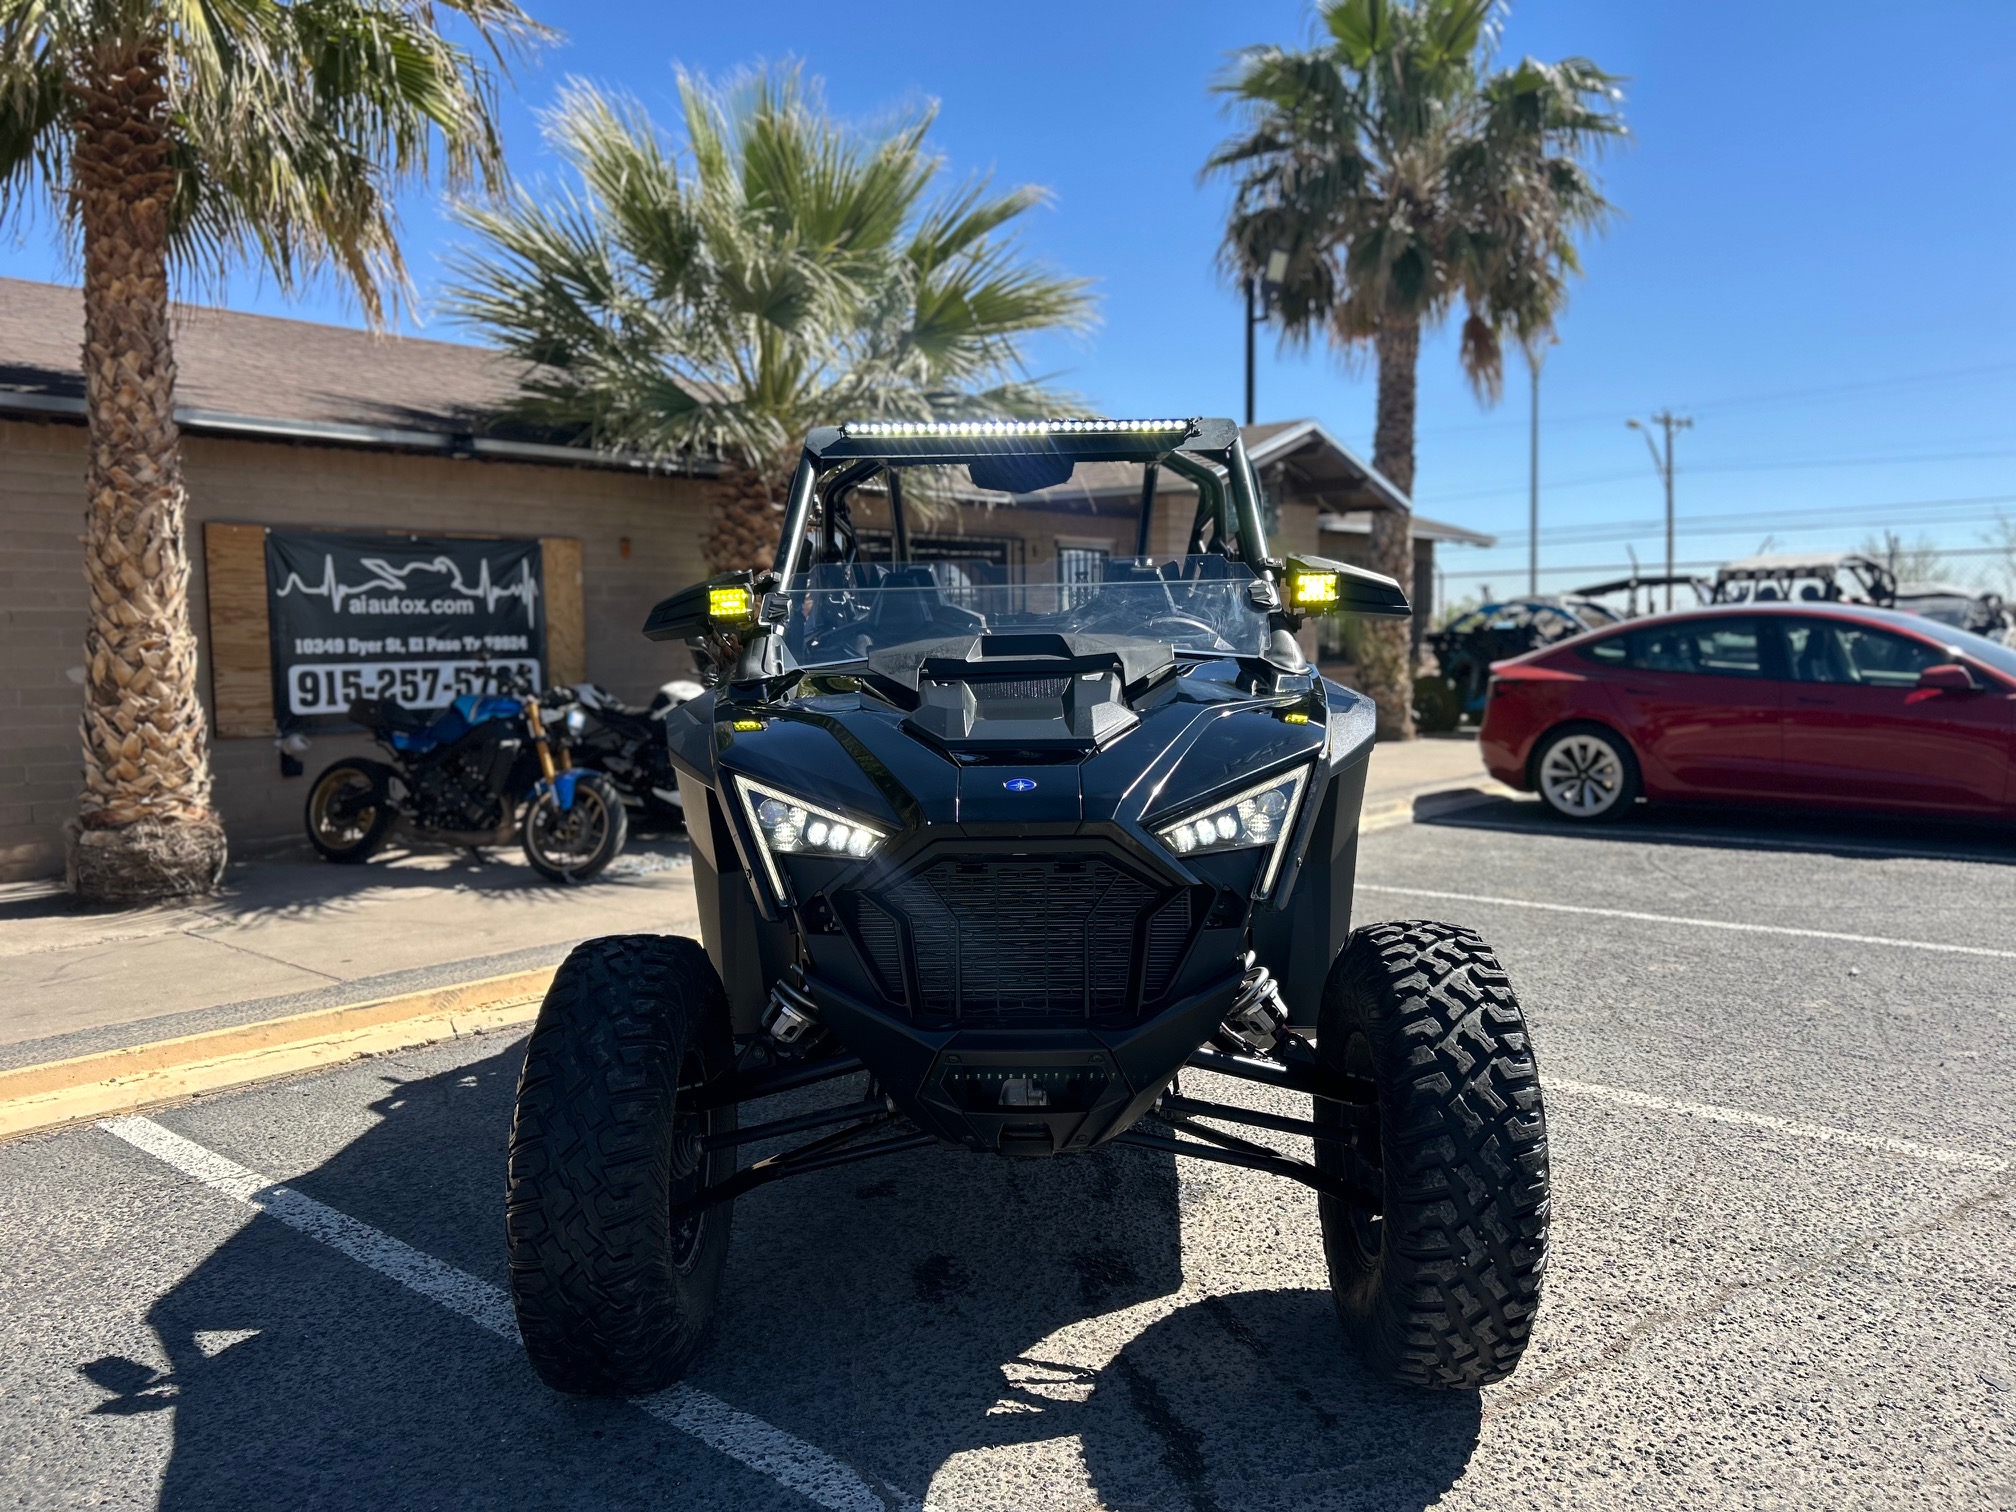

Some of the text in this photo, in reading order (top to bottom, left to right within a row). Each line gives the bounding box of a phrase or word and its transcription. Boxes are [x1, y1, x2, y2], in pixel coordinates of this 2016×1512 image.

[348, 594, 475, 615] aiautox.com
[294, 637, 345, 655] 10349
[347, 637, 383, 657] Dyer
[408, 636, 425, 653] El
[426, 635, 462, 653] Paso
[297, 665, 532, 708] 915-257-57
